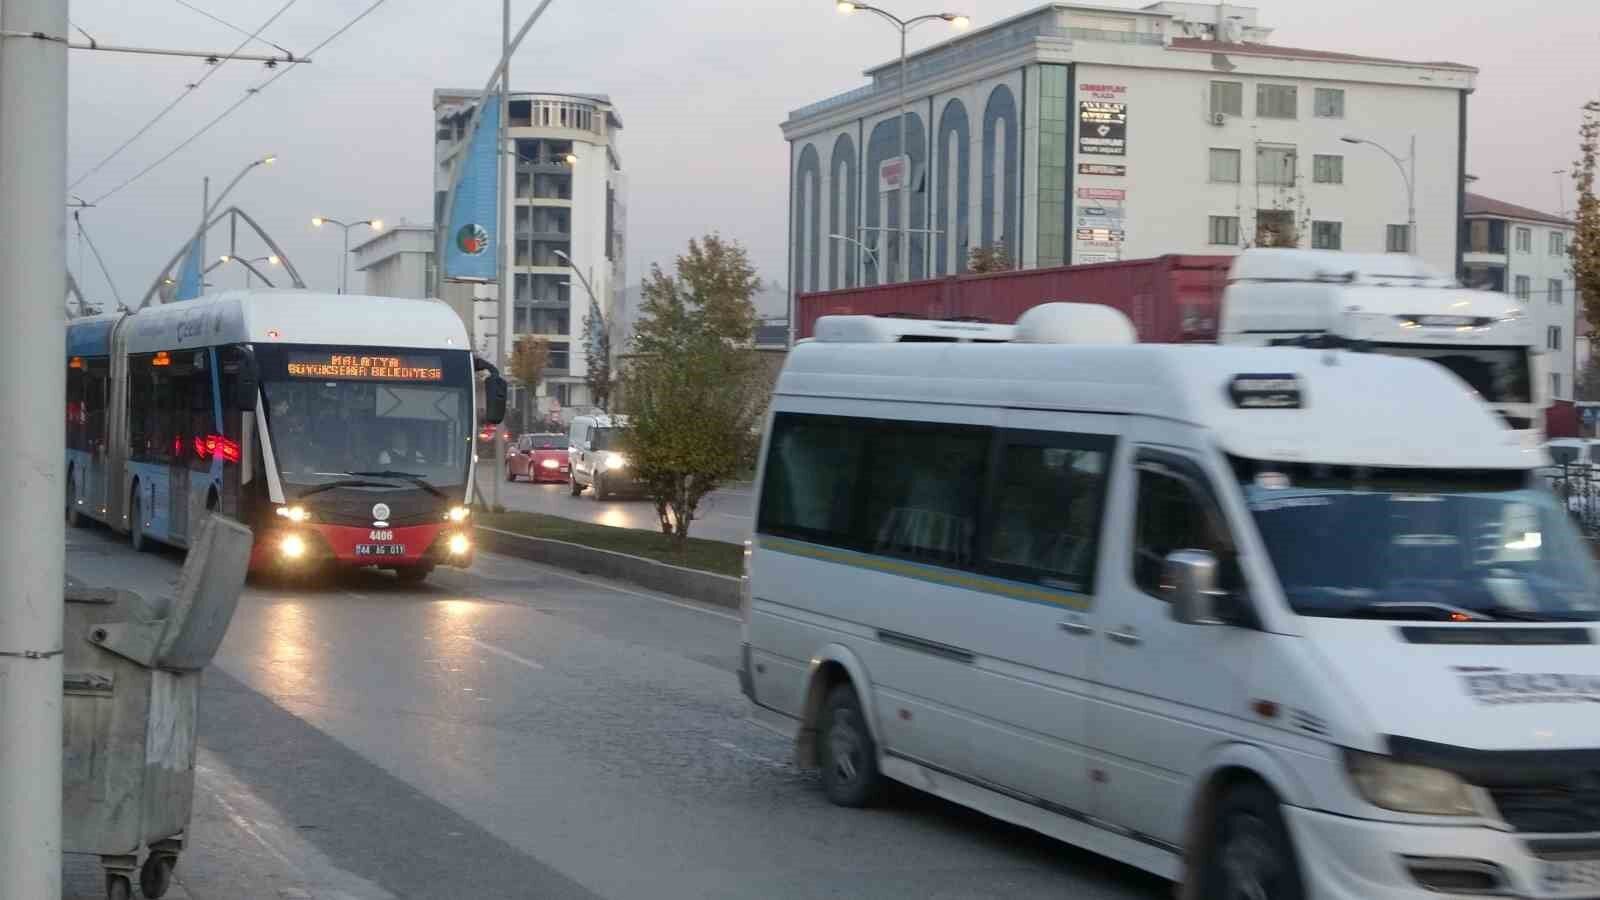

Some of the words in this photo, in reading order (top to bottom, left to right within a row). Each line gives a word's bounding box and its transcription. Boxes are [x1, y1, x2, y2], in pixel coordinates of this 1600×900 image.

[1081, 111, 1126, 120] AVUKT
[331, 355, 400, 367] MALATYA
[369, 529, 393, 541] 4406
